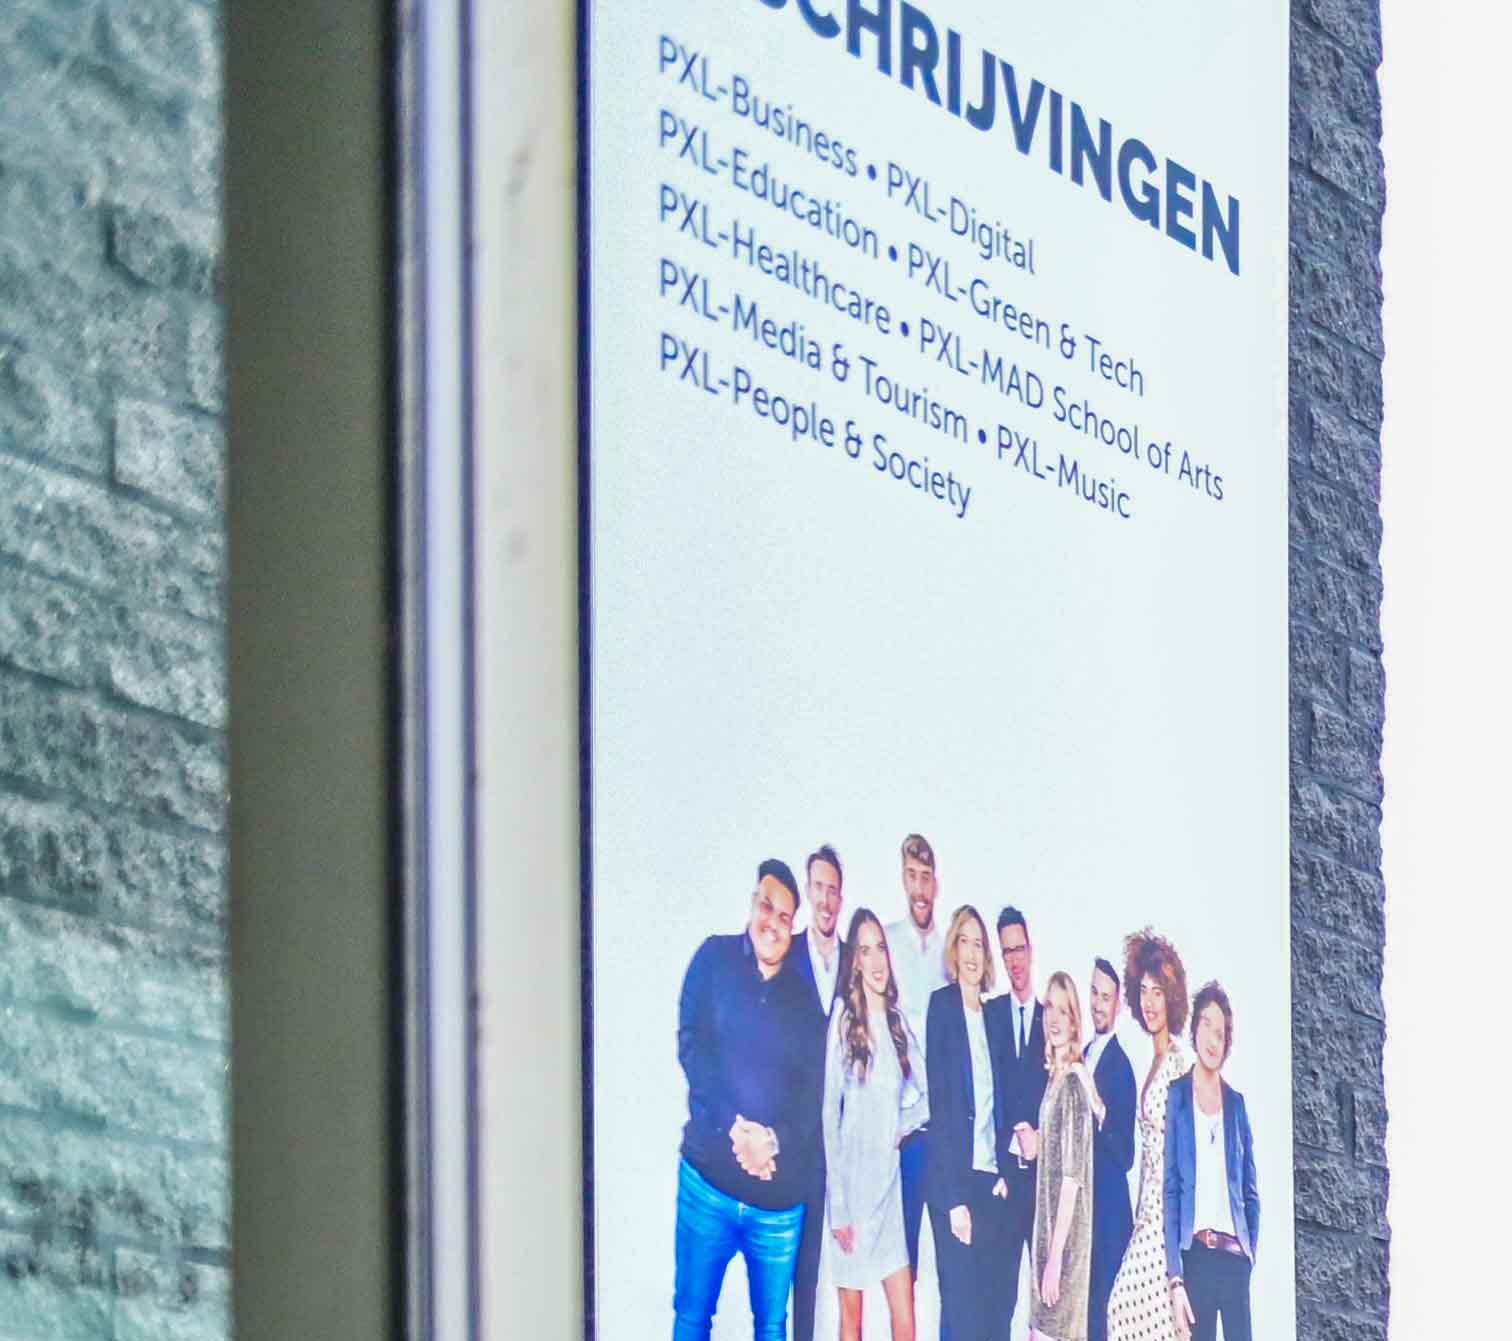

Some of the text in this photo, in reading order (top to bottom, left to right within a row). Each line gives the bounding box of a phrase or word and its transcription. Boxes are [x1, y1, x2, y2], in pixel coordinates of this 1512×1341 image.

[658, 34, 1036, 276] PXL-Business PXL-Digital
[658, 108, 1144, 397] PXL-Education PXL-Green & Tech
[760, 0, 1240, 277] CHRIJVINGEN
[658, 182, 1224, 501] PXL-Healthcare PXL-MAD School of Arts
[658, 256, 1131, 519] PXL-Media & Tourism PXL-Music
[658, 331, 972, 520] PXL-People & Society
